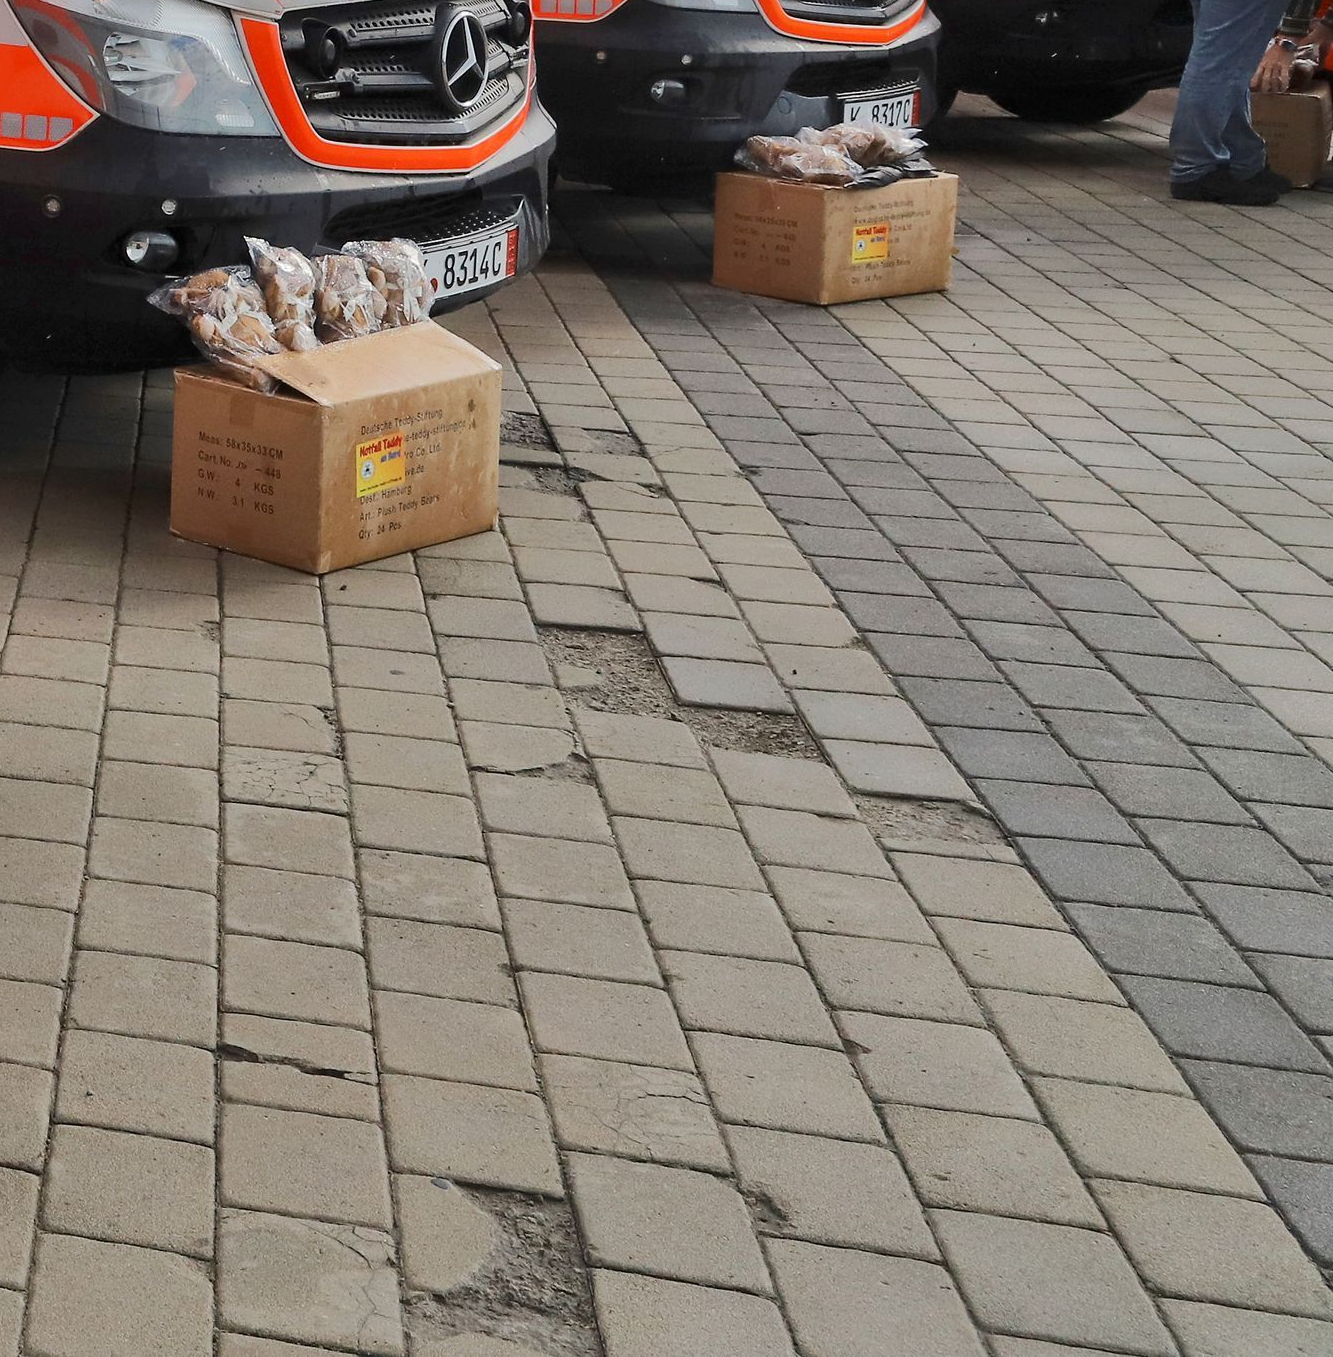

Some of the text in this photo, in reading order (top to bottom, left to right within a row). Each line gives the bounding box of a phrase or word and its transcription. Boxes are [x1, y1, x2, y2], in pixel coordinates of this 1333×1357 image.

[443, 241, 502, 290] 8314C
[268, 447, 283, 460] CM
[253, 482, 274, 496] KGS
[253, 501, 275, 515] KGS
